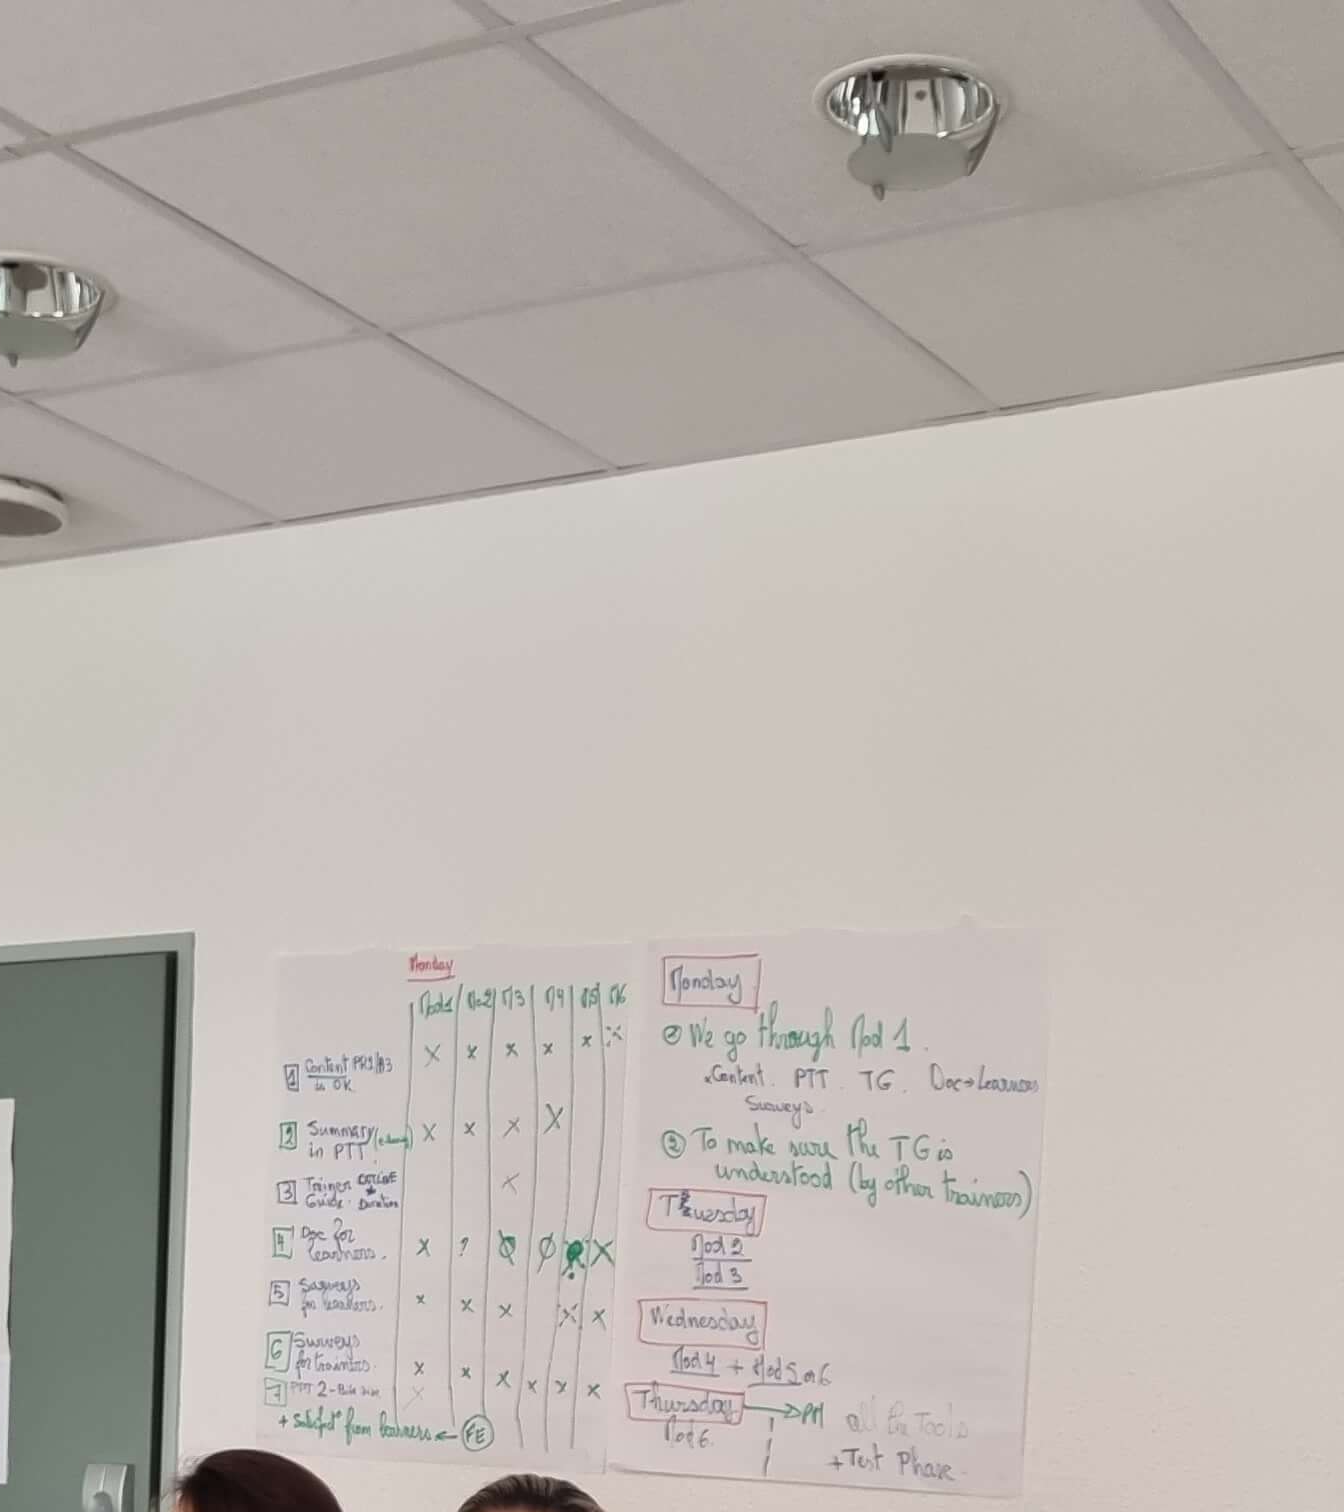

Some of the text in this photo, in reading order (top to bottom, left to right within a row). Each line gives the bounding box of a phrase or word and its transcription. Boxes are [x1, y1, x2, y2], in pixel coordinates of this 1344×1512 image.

[670, 964, 743, 1005] Monday
[690, 1019, 713, 1048] We
[724, 1029, 747, 1063] go
[758, 1000, 835, 1063] through
[304, 1053, 350, 1073] Content
[858, 1069, 896, 1091] TG
[309, 1142, 324, 1158] in
[691, 1126, 717, 1151] To
[728, 1122, 776, 1156] make
[846, 1117, 880, 1160] the
[888, 1134, 930, 1161] TG
[937, 1138, 953, 1161] is
[715, 1158, 833, 1191] understood
[884, 1164, 934, 1199] other
[649, 1304, 761, 1345] Wednesday
[631, 1380, 736, 1425] Thursday
